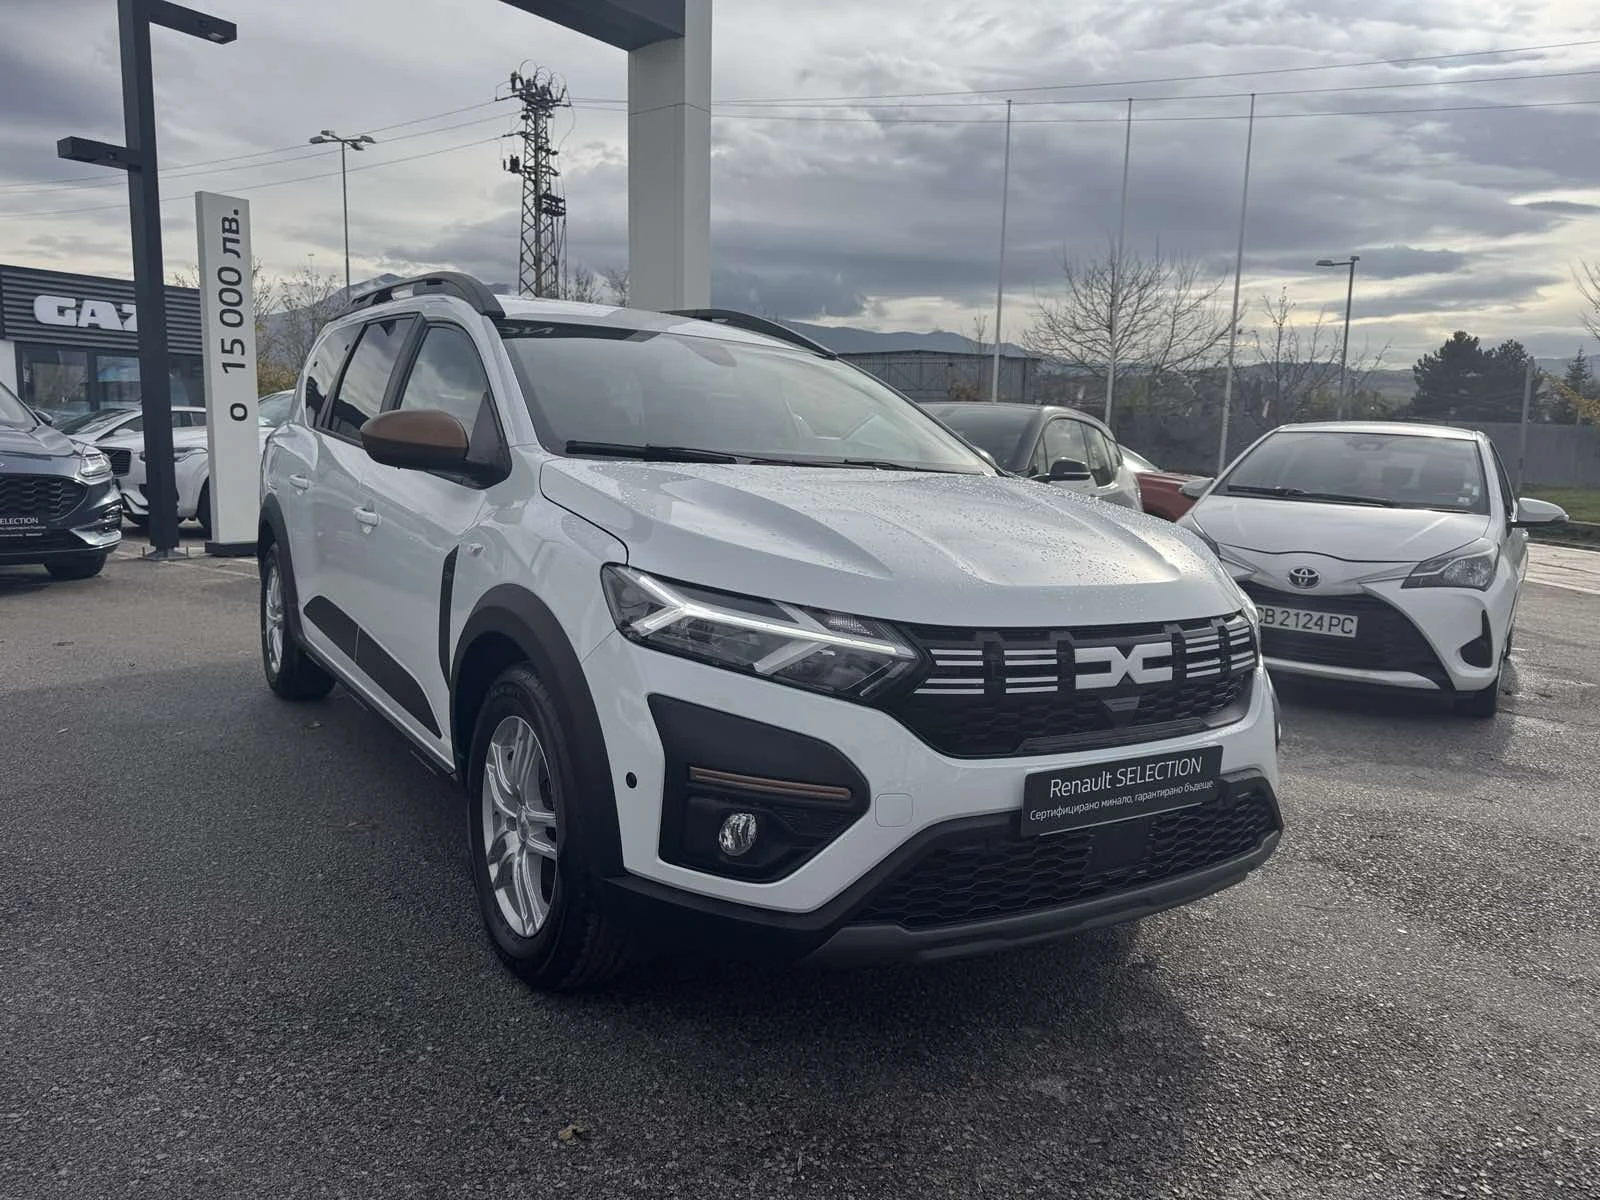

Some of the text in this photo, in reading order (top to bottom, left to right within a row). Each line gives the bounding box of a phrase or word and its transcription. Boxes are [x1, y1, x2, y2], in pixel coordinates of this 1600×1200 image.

[221, 208, 241, 258] лв.
[217, 266, 244, 328] 000
[221, 338, 246, 374] 15
[1279, 610, 1324, 631] 2124
[1327, 615, 1354, 635] PC
[1049, 756, 1203, 798] Renault SELECTION
[1030, 801, 1100, 822] Сертифицирано
[1101, 795, 1134, 810] минало,
[1135, 785, 1183, 803] гарантирано
